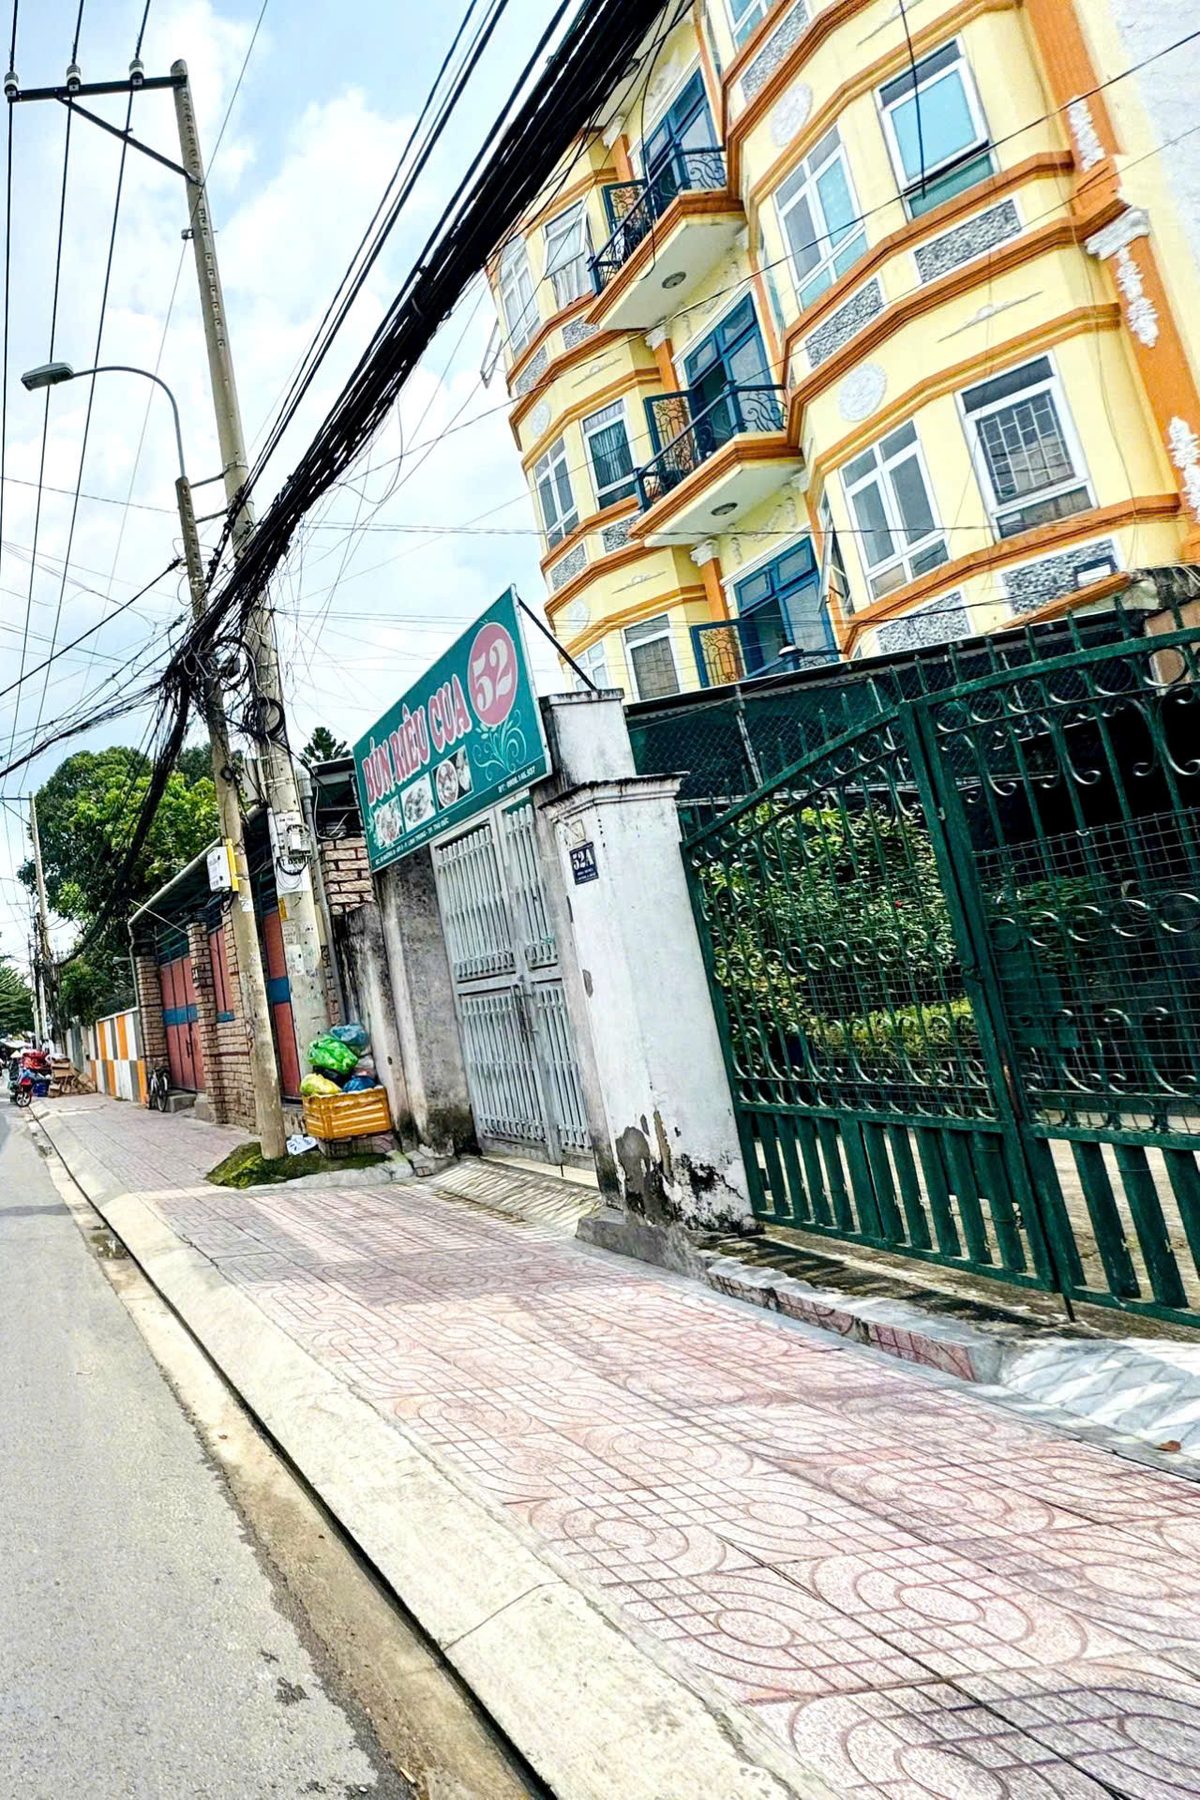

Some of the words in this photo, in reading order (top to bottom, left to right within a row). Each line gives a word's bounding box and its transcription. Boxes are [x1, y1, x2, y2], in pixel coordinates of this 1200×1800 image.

[362, 737, 394, 805] BÚN
[389, 703, 430, 785] RIÊU
[428, 673, 472, 753] CUA
[472, 638, 513, 712] 52
[572, 848, 594, 870] 52A
